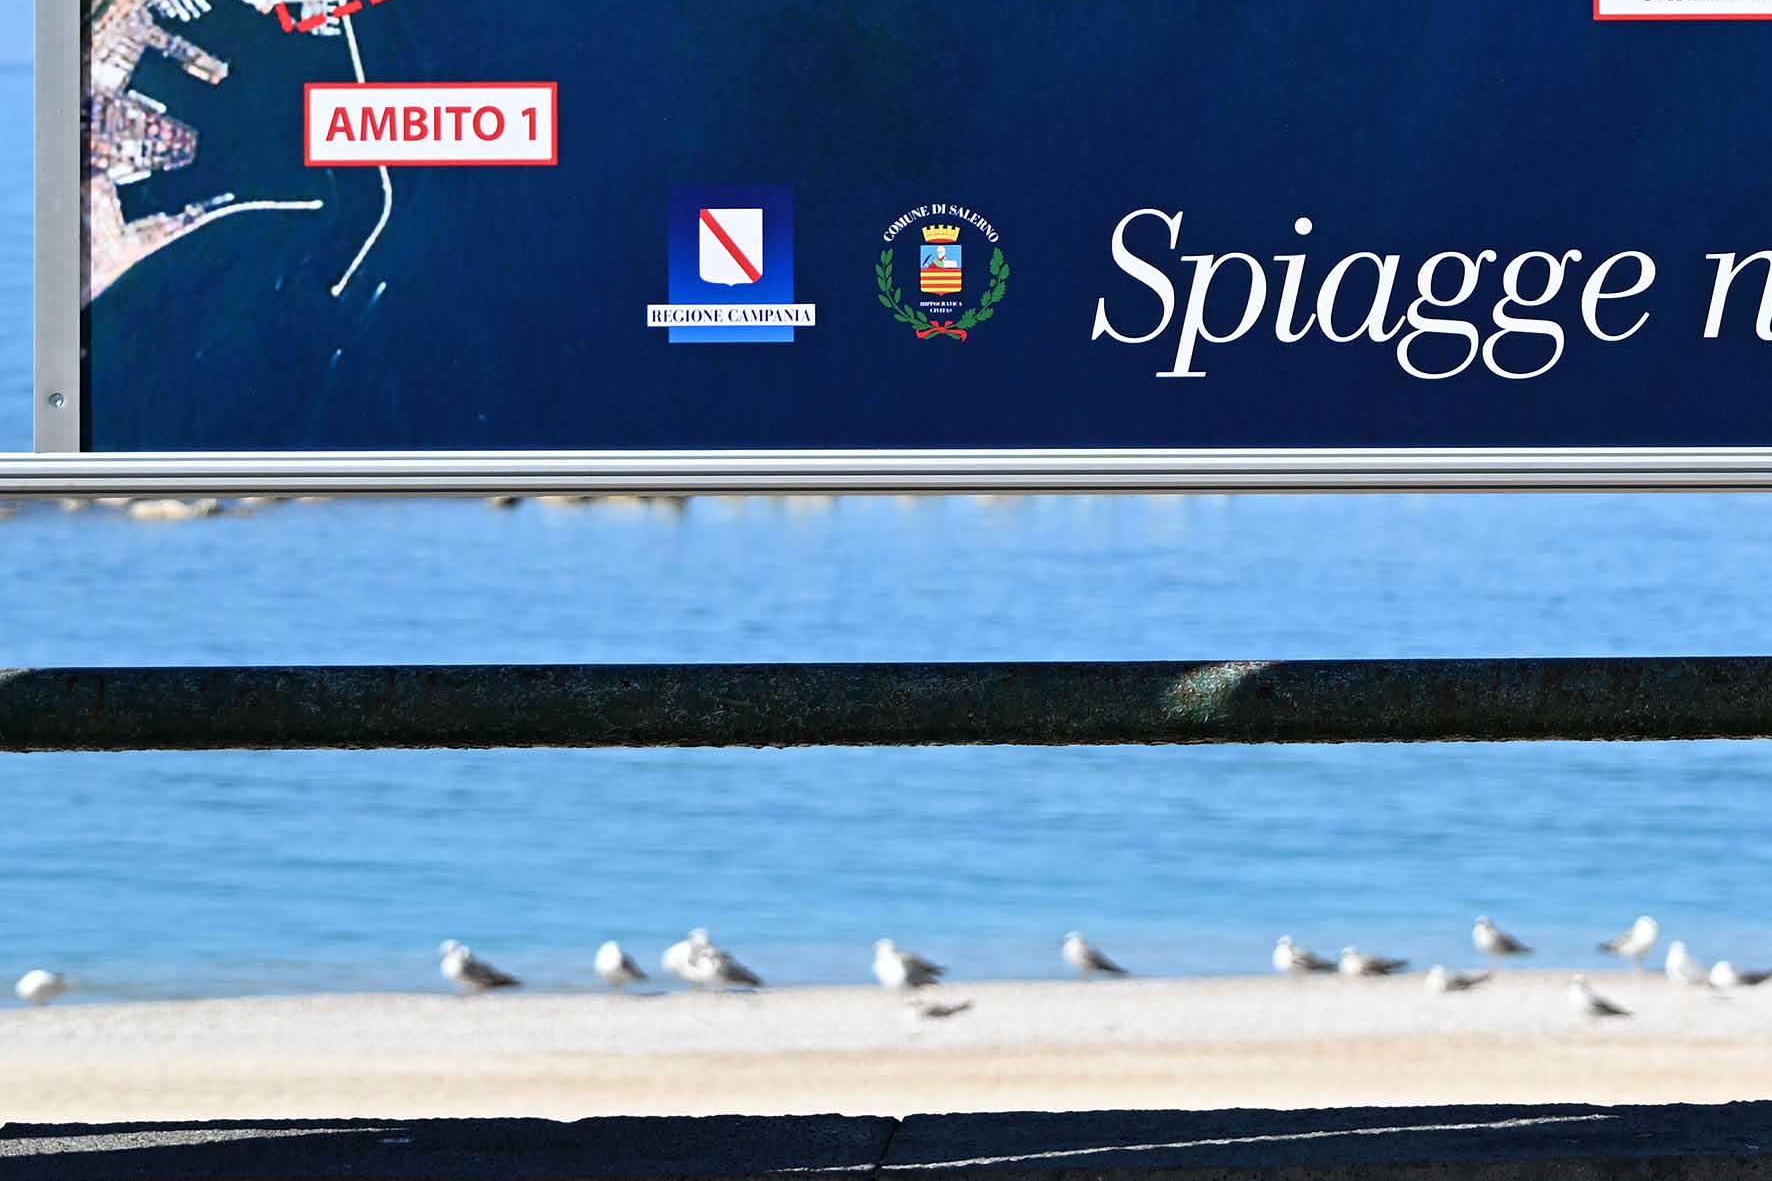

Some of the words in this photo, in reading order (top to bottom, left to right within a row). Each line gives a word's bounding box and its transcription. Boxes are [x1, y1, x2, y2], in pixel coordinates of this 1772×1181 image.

[325, 105, 506, 142] AMBITO
[521, 105, 537, 142] 1
[883, 205, 930, 242] COMUNE
[932, 203, 946, 215] DI
[949, 204, 1000, 243] SALERNO
[1091, 208, 1655, 380] Spiagge
[652, 308, 724, 323] REGIONE
[728, 308, 811, 323] CAMPANIA
